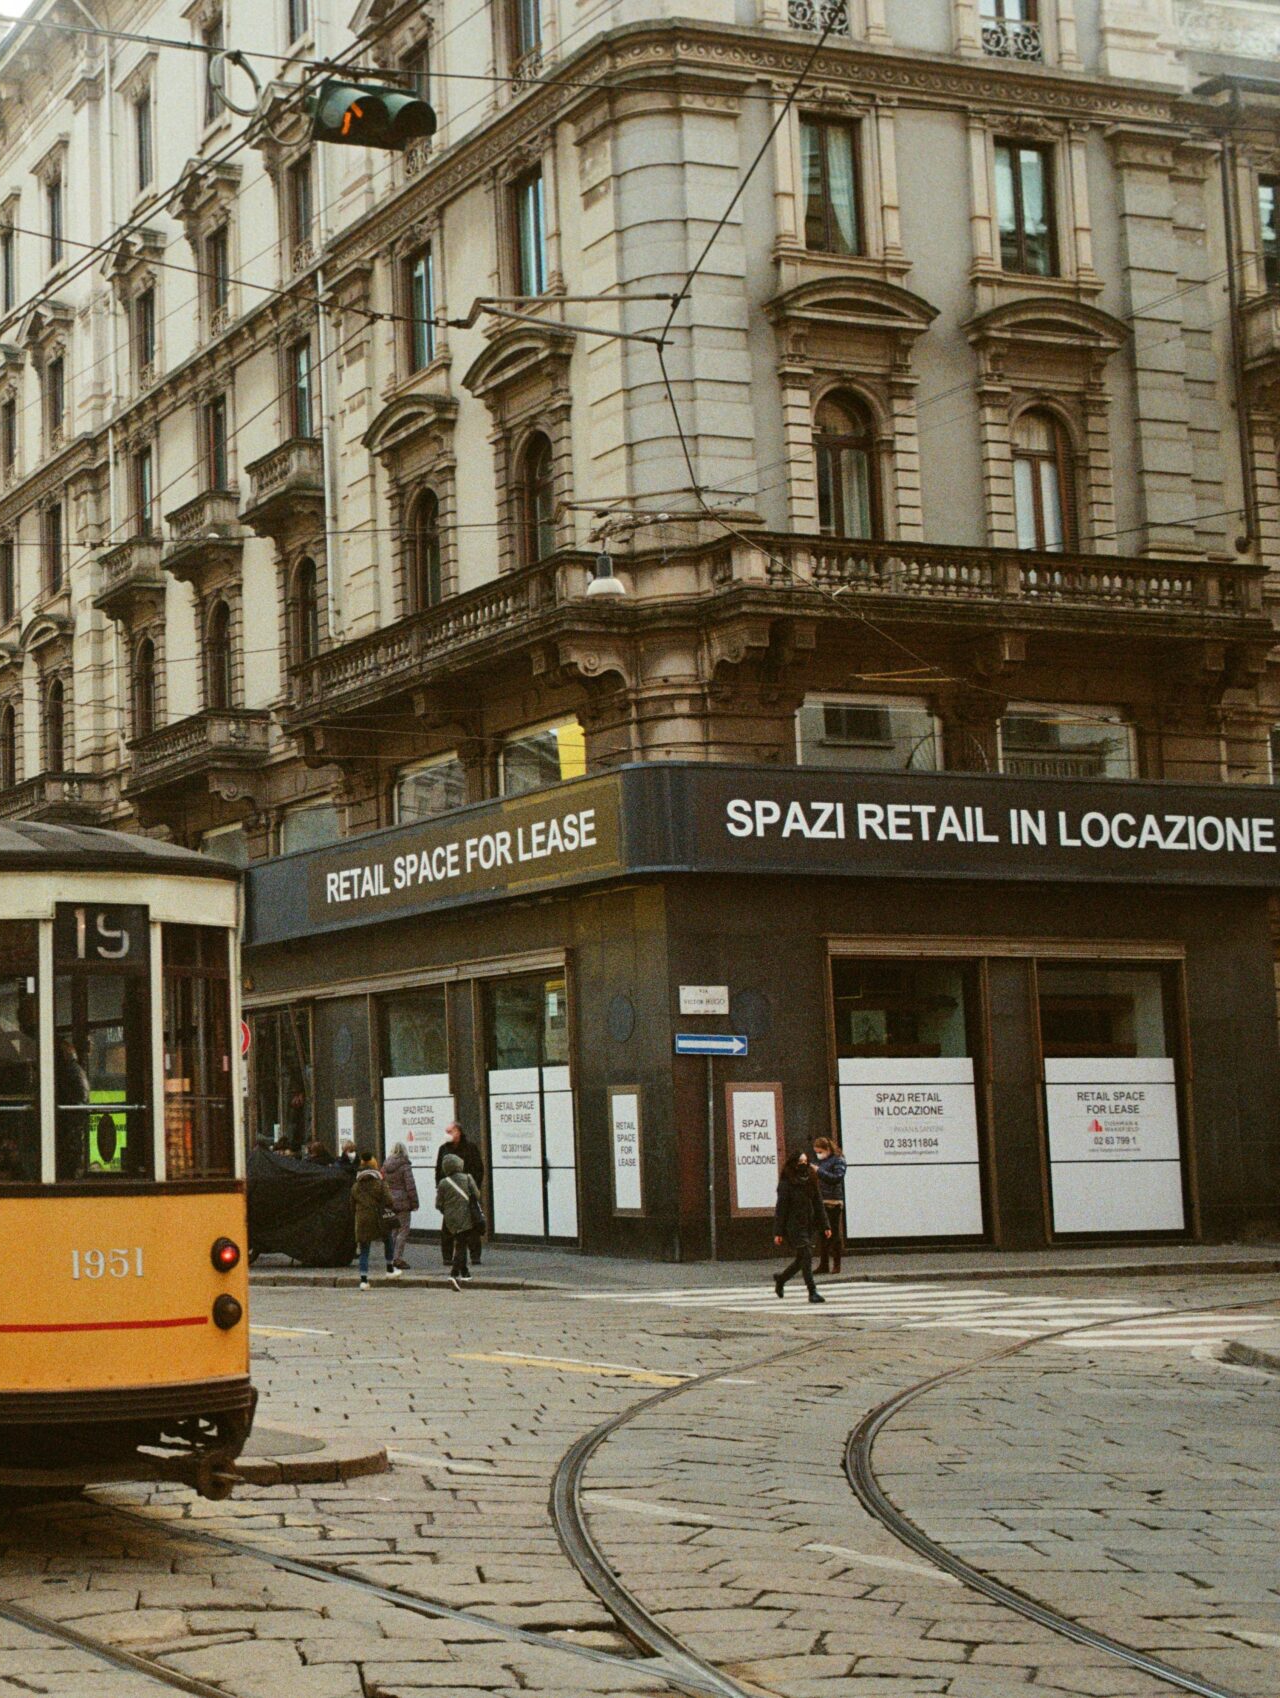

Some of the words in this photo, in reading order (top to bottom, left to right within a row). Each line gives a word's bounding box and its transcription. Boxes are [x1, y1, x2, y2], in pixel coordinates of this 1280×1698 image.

[725, 798, 845, 839] SPAZI
[857, 802, 999, 843] RETAIL
[1009, 808, 1047, 846] IN
[1058, 810, 1277, 853] LOCAZIONE
[326, 863, 390, 903] RETAIL
[394, 843, 460, 890] SPACE
[465, 830, 513, 873] FOR
[518, 809, 597, 862] LEASE
[875, 1092, 905, 1103] SPAZI
[907, 1092, 942, 1102] RETAIL
[1076, 1091, 1110, 1101] RETAIL
[1113, 1091, 1145, 1101] SPACE
[495, 1101, 515, 1110] RETAIL
[515, 1100, 535, 1110] SPACE
[1086, 1105, 1107, 1114] FOR
[1109, 1104, 1140, 1114] LEASE
[874, 1106, 884, 1116] IN
[887, 1105, 944, 1116] LOCAZIONE
[500, 1114, 513, 1123] FOR
[513, 1113, 532, 1123] LEASE
[615, 1121, 636, 1130] RETAIL
[742, 1119, 769, 1128] SPAZI
[616, 1134, 636, 1142] SPACE
[739, 1131, 772, 1141] RETAIL
[883, 1138, 895, 1148] 02
[620, 1146, 633, 1154] FOR
[750, 1144, 760, 1153] IN
[618, 1158, 637, 1167] LEASE
[737, 1155, 776, 1166] LOCAZIONE
[72, 1247, 144, 1280] 1951
